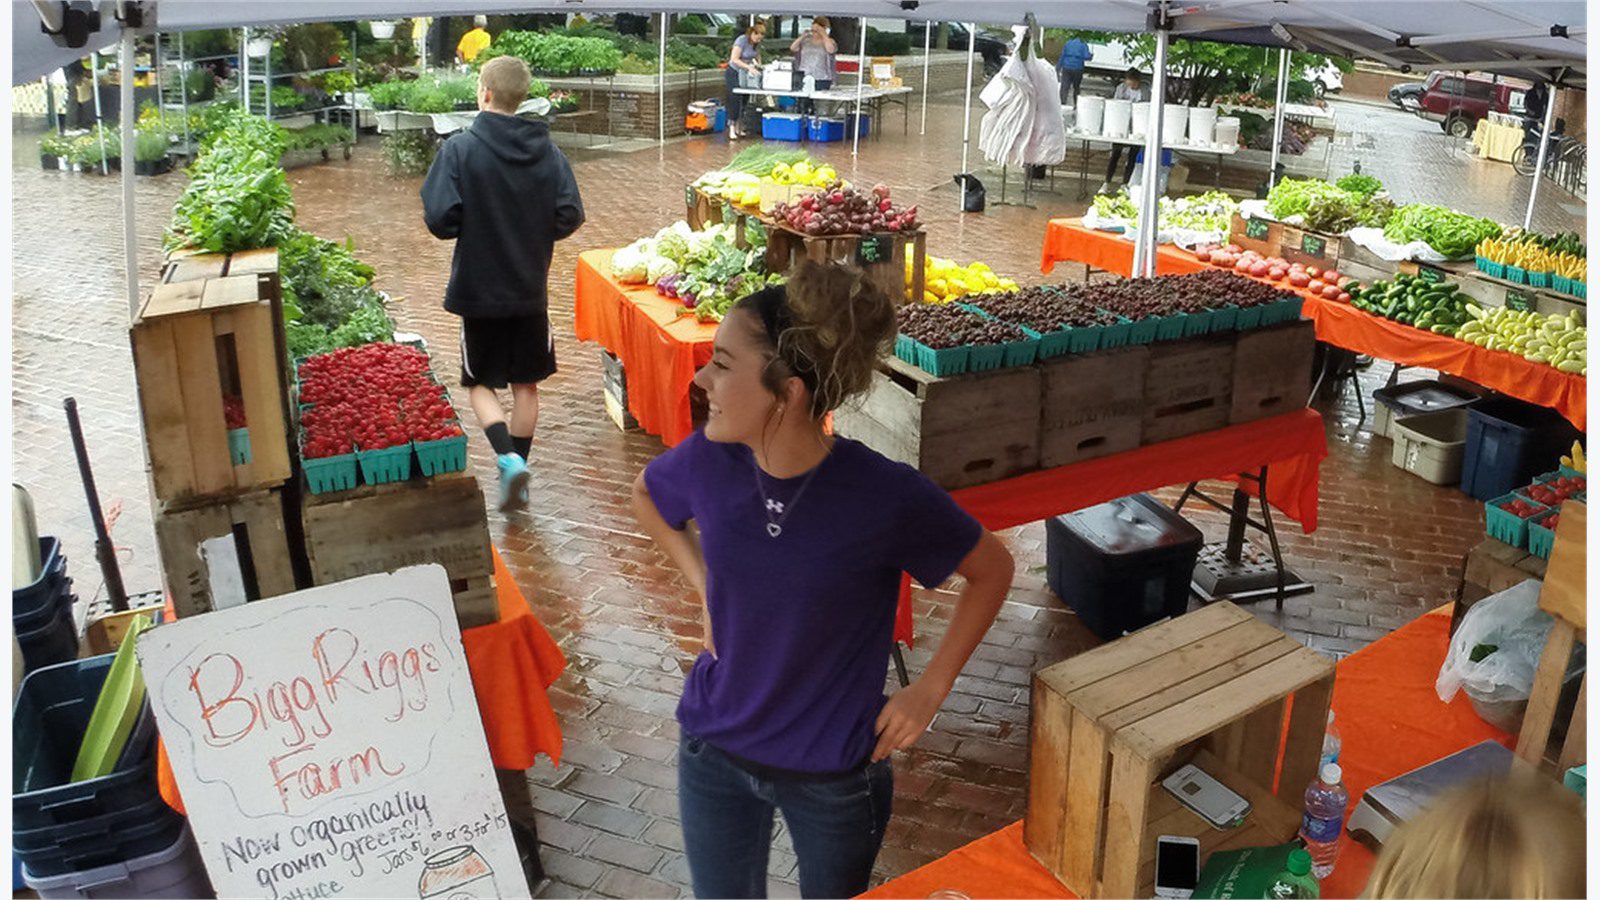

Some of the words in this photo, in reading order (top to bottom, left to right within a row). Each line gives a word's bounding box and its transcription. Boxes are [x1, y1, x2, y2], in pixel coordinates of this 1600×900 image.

[188, 653, 332, 747] Bigg
[312, 628, 441, 722] Riggs
[269, 743, 405, 812] Farm
[221, 833, 279, 872] Now
[290, 791, 432, 856] organically
[256, 852, 326, 899] grown
